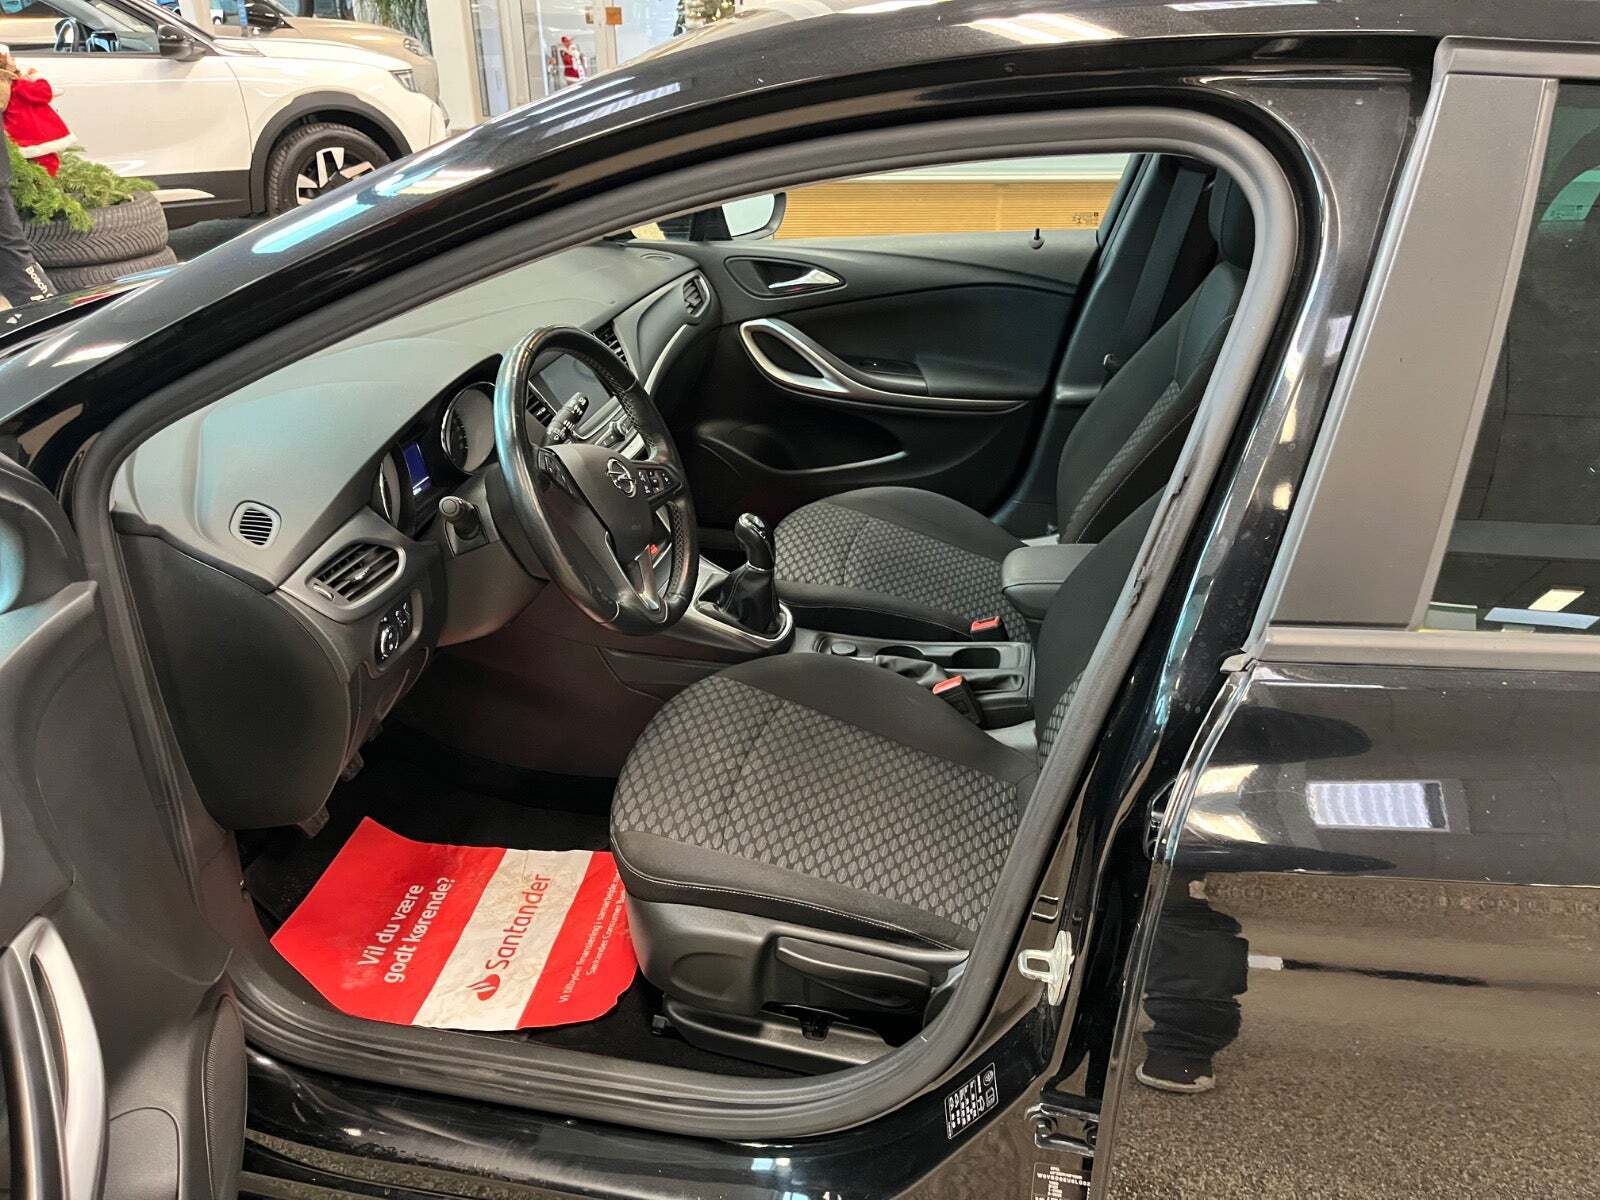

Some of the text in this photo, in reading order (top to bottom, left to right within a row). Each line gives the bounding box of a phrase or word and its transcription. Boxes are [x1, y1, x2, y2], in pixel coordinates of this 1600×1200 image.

[25, 266, 48, 294] Bosch
[356, 884, 424, 966] Vil du være
[383, 877, 455, 983] godt kørende?
[485, 873, 551, 970] Santander
